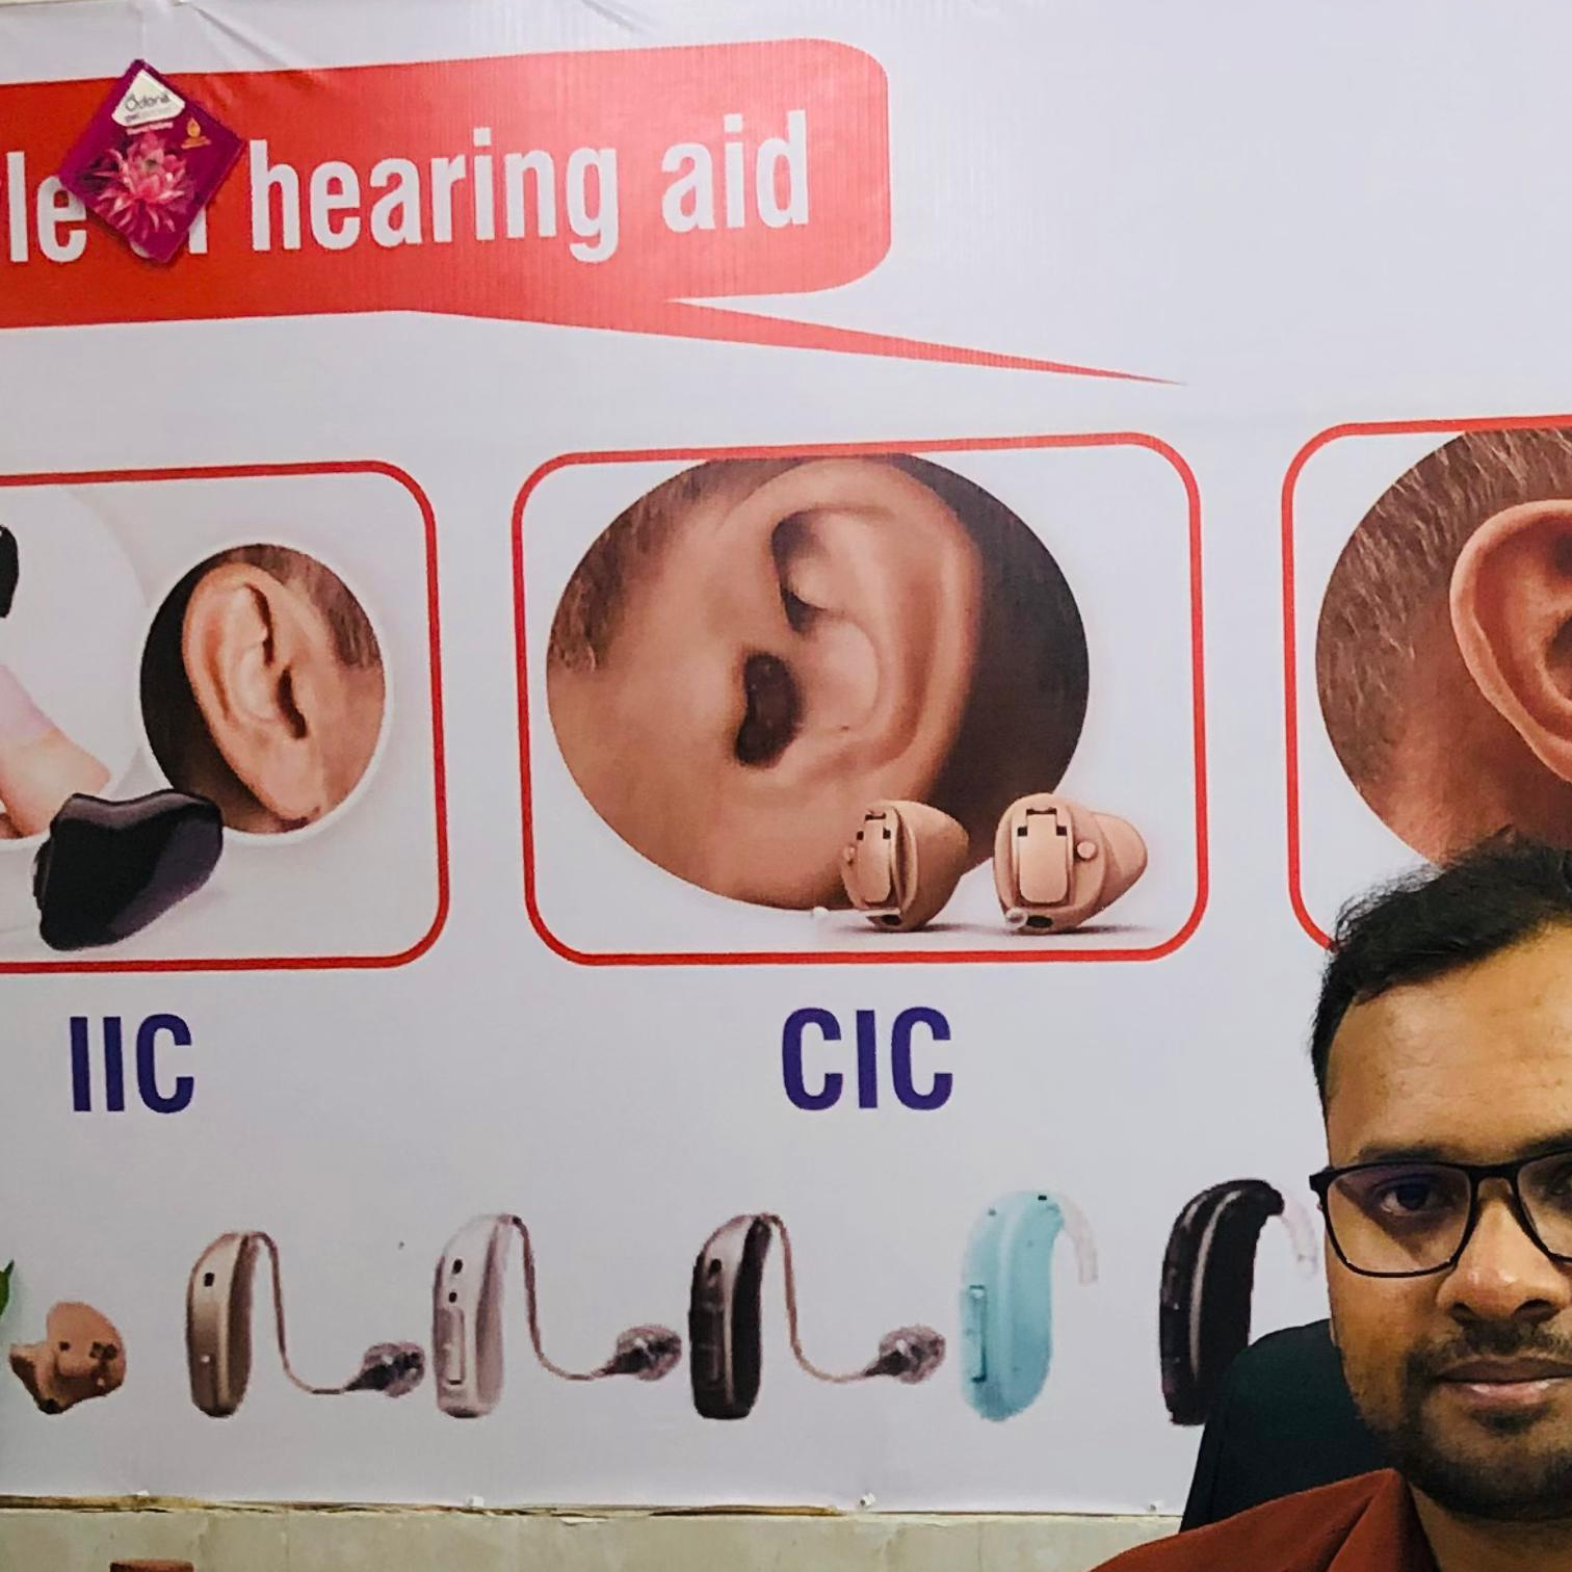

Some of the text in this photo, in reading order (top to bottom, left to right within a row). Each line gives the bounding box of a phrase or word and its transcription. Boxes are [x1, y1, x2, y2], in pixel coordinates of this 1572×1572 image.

[0, 150, 88, 263] le
[251, 126, 620, 263] hearing
[661, 109, 809, 233] aid
[70, 1013, 195, 1114] IIC
[781, 1007, 954, 1111] CIC
